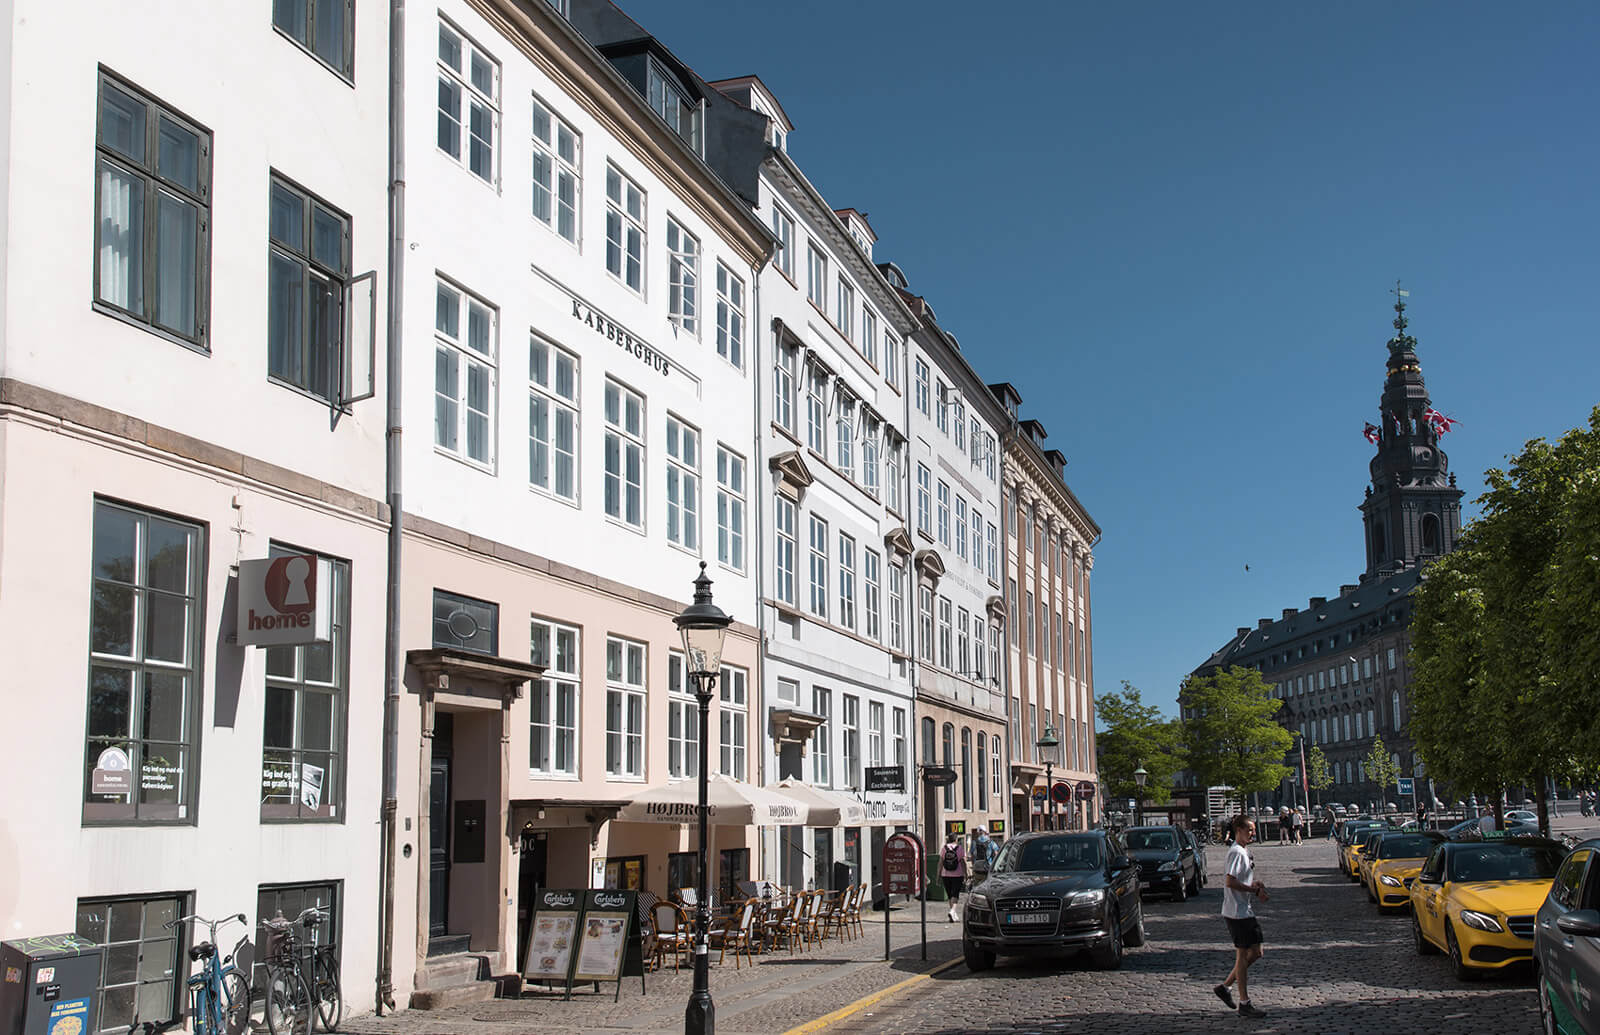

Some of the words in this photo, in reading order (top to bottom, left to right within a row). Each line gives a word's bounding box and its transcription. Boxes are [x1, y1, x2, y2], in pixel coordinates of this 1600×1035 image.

[572, 300, 669, 376] KARBERGHUS
[248, 608, 310, 631] home
[544, 892, 575, 904] Carlsberg
[594, 893, 626, 905] Carlsberg
